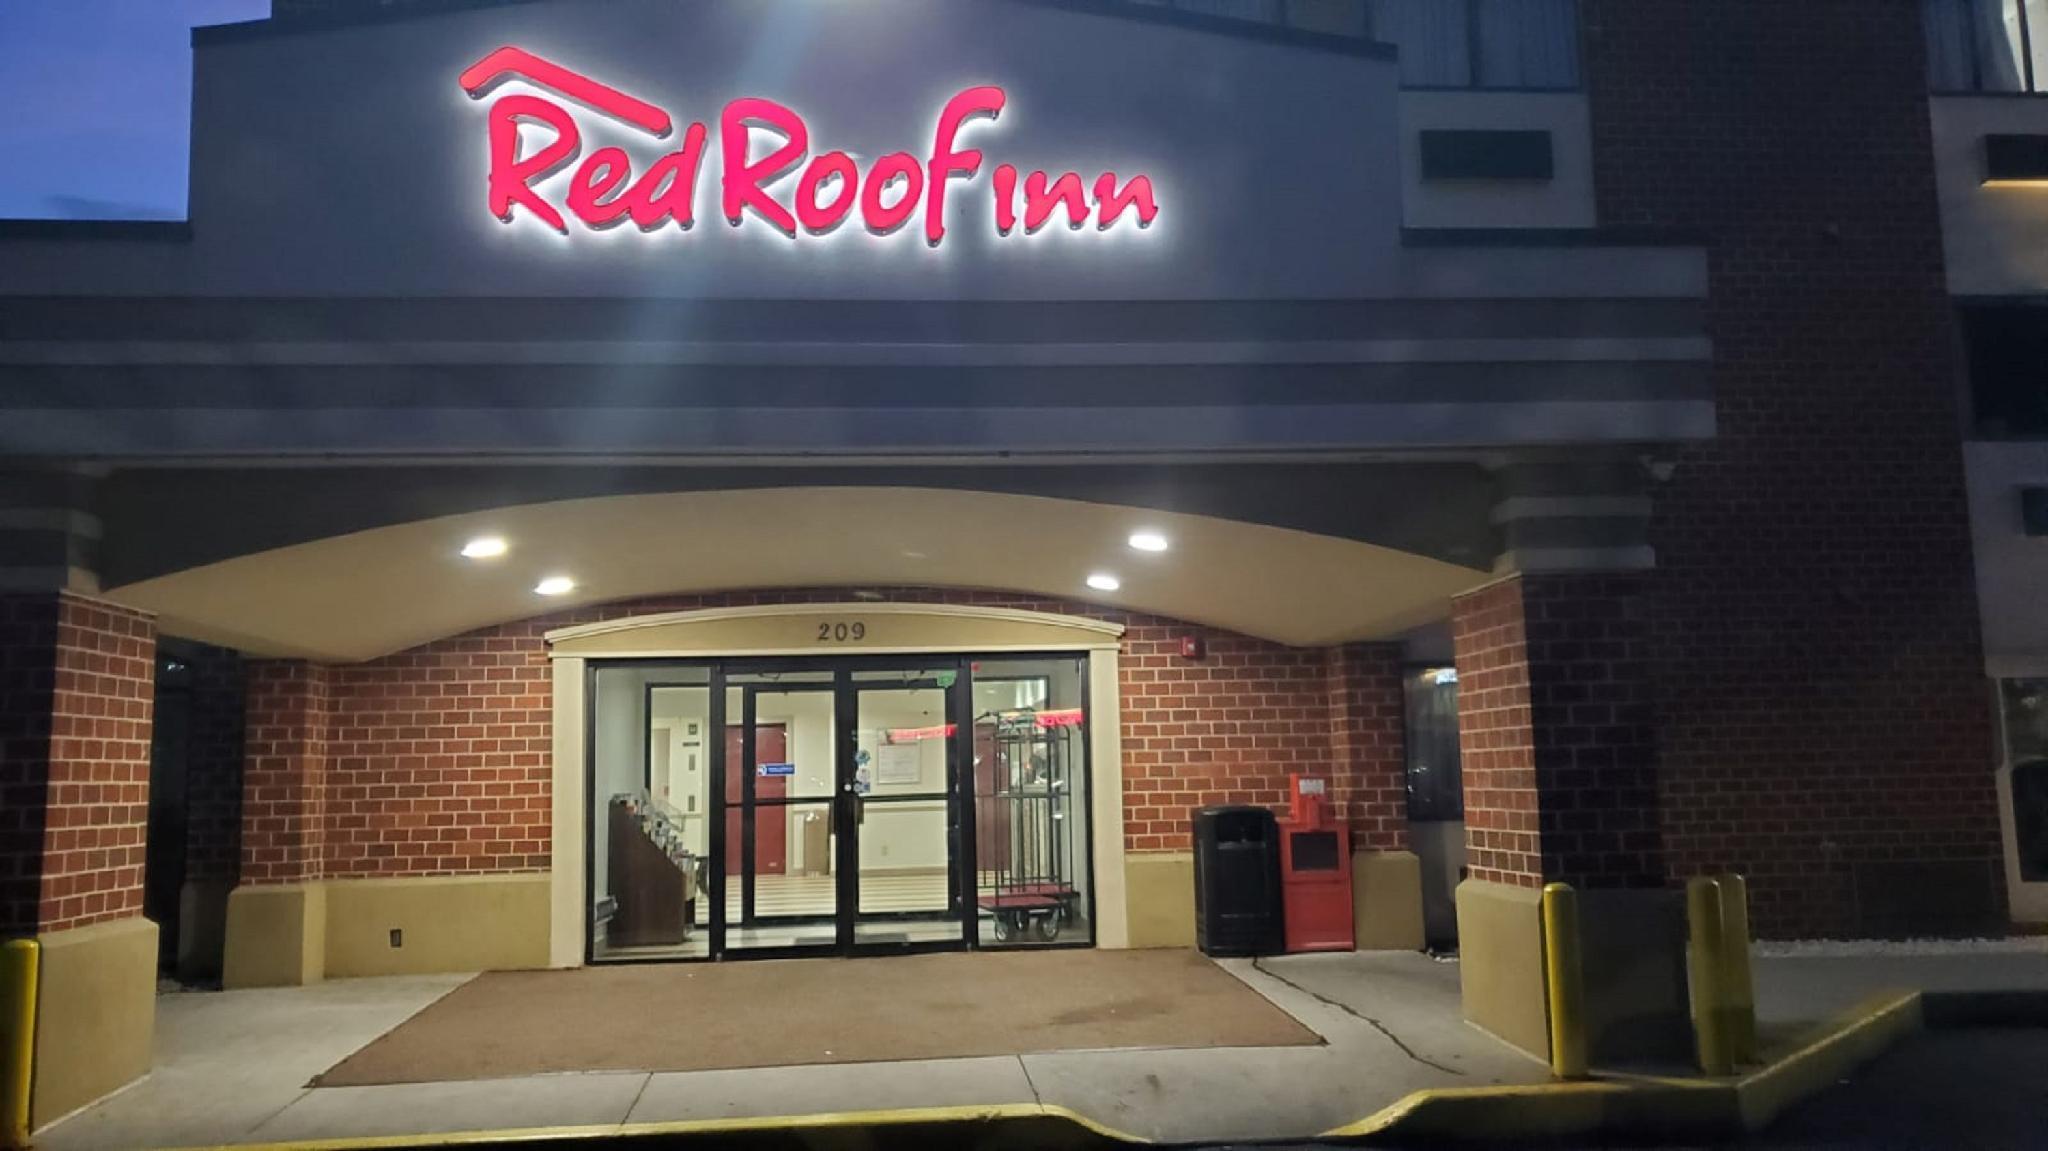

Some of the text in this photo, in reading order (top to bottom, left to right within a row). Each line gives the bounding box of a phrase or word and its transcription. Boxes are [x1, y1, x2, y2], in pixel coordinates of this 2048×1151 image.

[488, 95, 707, 236] Red
[722, 86, 1005, 246] Roof
[818, 622, 865, 641] 209
